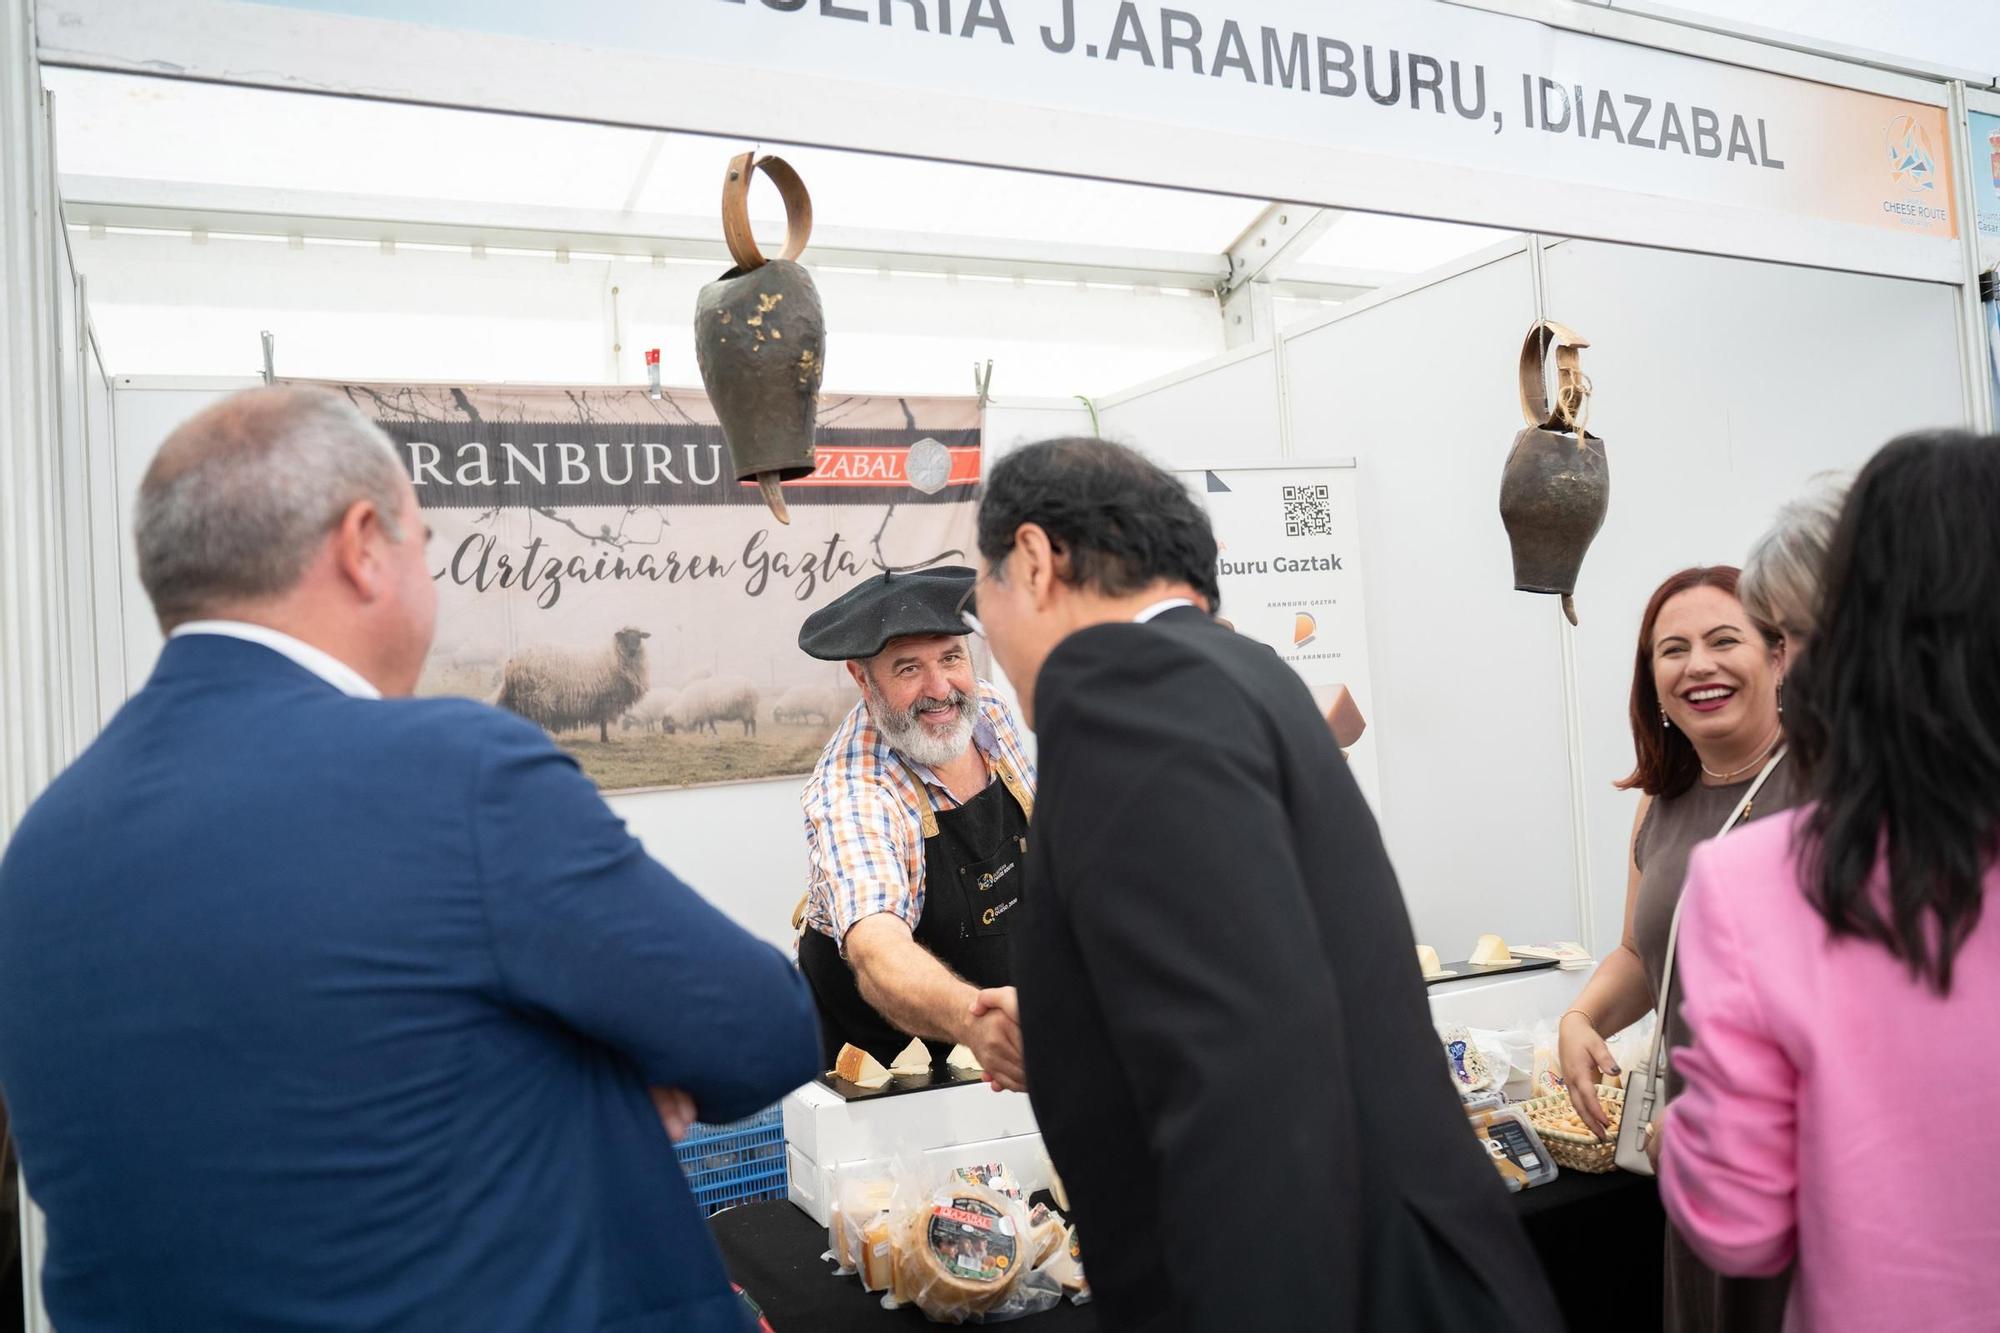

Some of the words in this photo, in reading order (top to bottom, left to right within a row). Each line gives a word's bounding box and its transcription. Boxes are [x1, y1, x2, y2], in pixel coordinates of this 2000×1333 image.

[718, 0, 1014, 45] RIA
[1040, 0, 1504, 135] J.ARAMBURU,
[1522, 73, 1786, 170] IDIAZABAL
[1883, 200, 1917, 217] CHEESE
[1918, 206, 1947, 221] ROUTE
[808, 453, 902, 479] ZABAL
[450, 532, 738, 610] Artzainaren
[742, 528, 868, 601] Gazta
[1272, 553, 1343, 573] Gaztak
